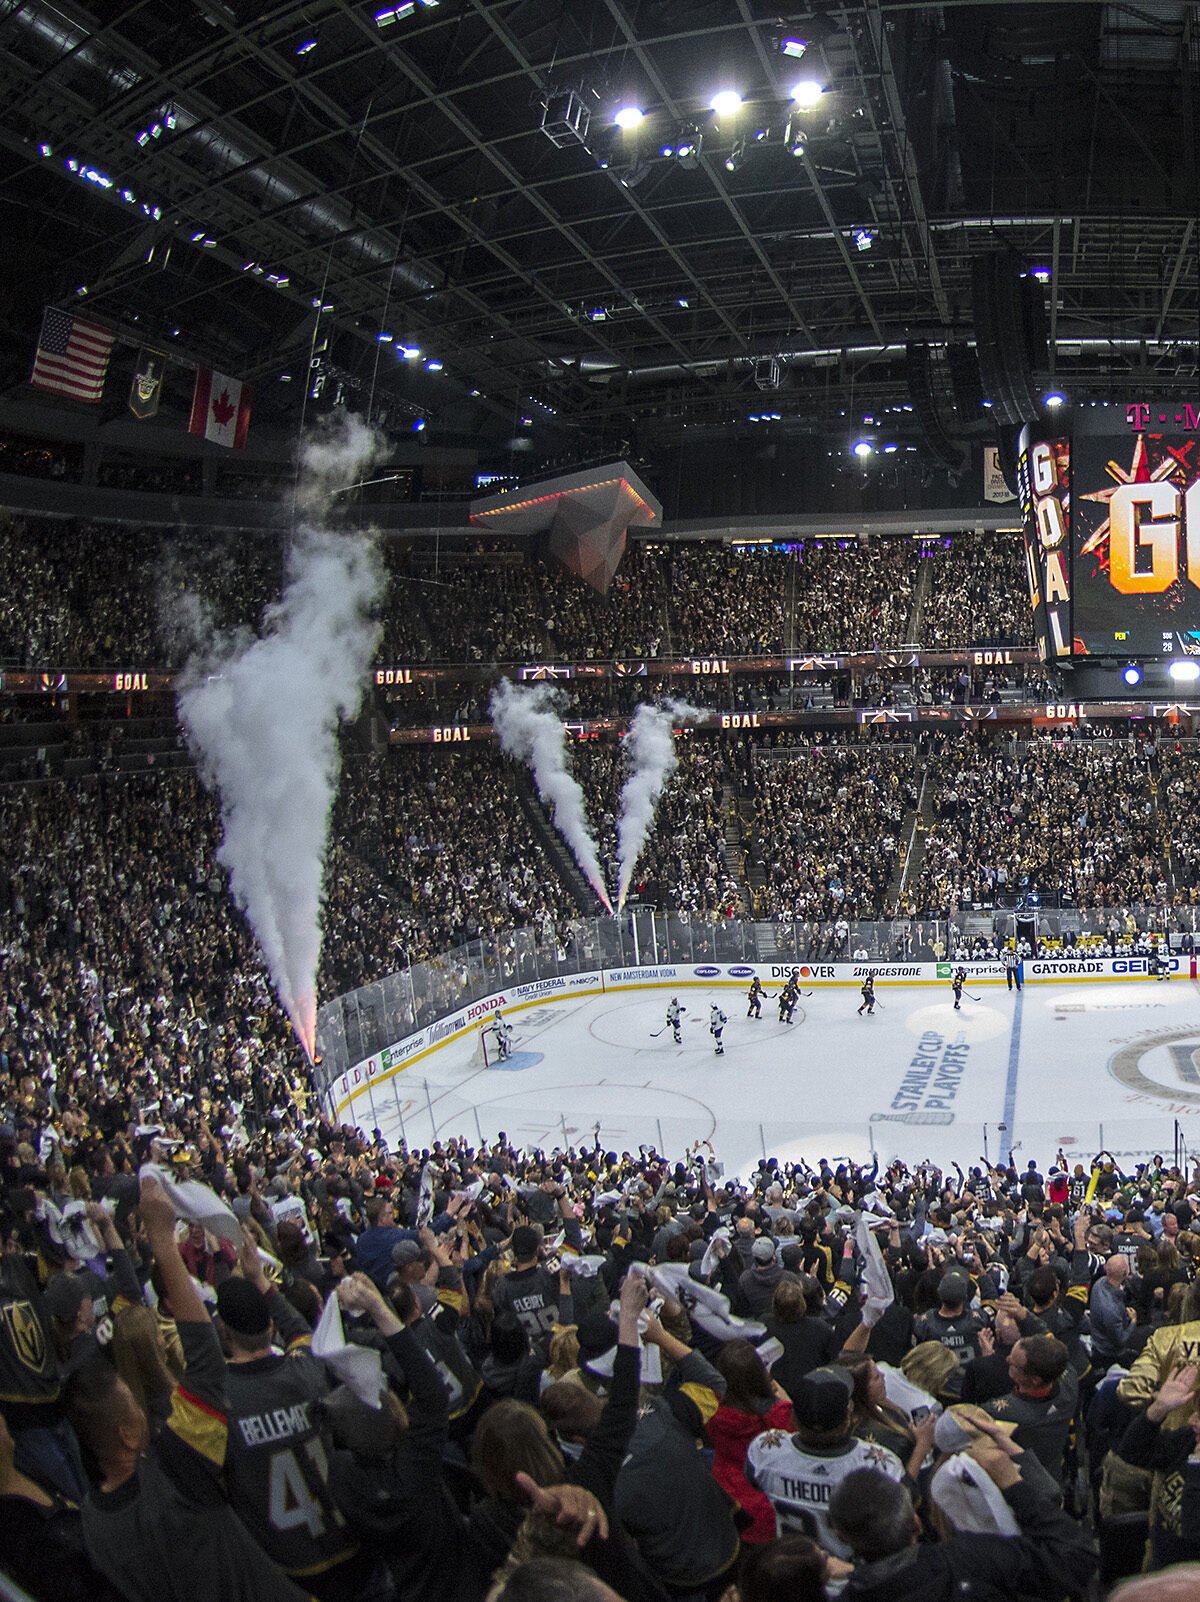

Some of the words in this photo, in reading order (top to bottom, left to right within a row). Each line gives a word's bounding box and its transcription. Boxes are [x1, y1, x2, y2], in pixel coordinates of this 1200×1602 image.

[1031, 442, 1073, 657] GOAL
[1162, 642, 1173, 652] 28
[974, 651, 1013, 665] GOAL
[692, 660, 730, 675] GOAL
[115, 673, 149, 690] GOAL
[376, 669, 413, 684] GOAL
[1046, 704, 1087, 719] GOAL
[721, 714, 761, 729] GOAL
[432, 726, 472, 742] GOAL
[853, 967, 922, 977] BRIDGESTONE
[941, 964, 1006, 980] enerprise
[1032, 961, 1104, 975] GATORADE
[1111, 958, 1180, 973] GEIO
[609, 973, 621, 982] NEW
[622, 970, 658, 981] AMSTERDAM
[659, 968, 677, 978] VODKA
[516, 983, 535, 996] NAVY
[535, 978, 566, 992] FEDERAL
[524, 993, 539, 1002] Credit
[539, 990, 553, 999] Union
[467, 995, 508, 1021] HONDA
[382, 1035, 425, 1065] enterprise
[890, 1052, 940, 1112] STANLEY
[917, 1030, 945, 1053] CUP
[924, 1043, 971, 1110] PLAYOFFS
[513, 1293, 545, 1313] FLEURY
[941, 1336, 964, 1346] SMITH
